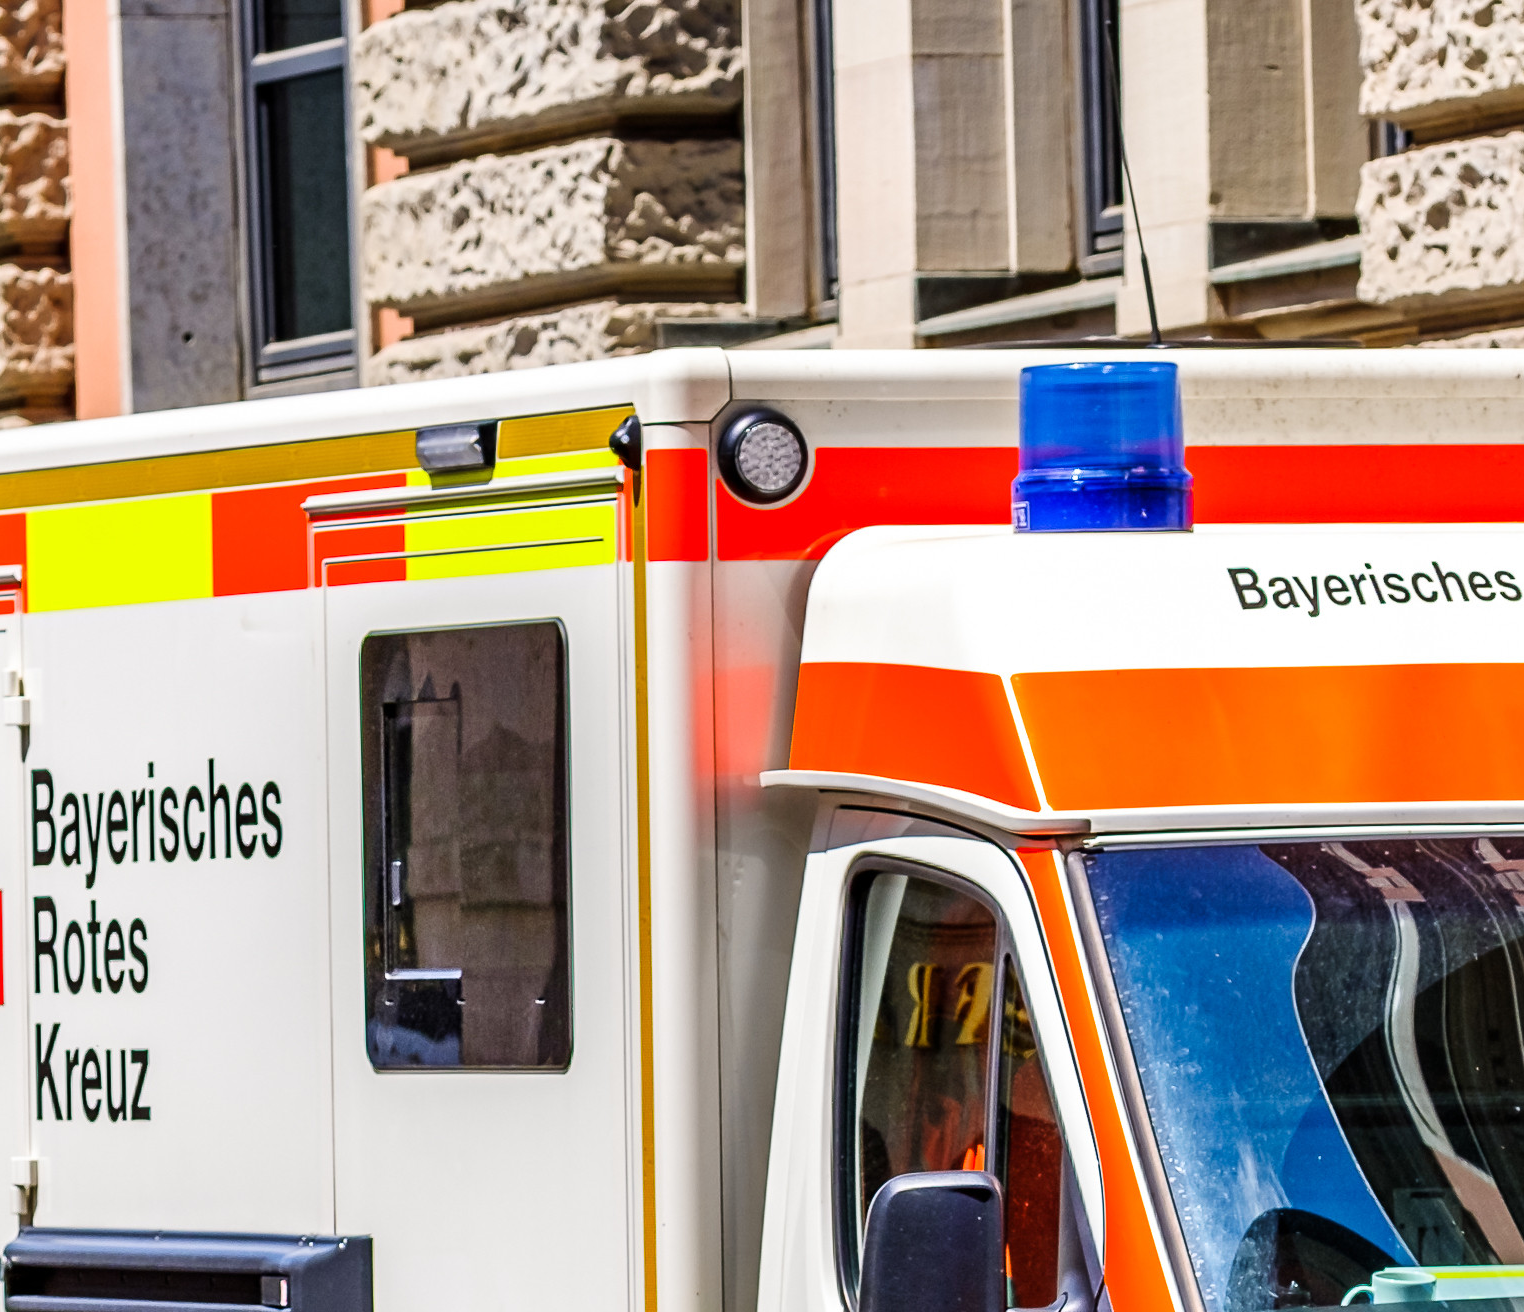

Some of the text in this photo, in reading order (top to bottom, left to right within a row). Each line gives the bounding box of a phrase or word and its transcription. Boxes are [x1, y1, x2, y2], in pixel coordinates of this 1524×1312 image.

[1227, 561, 1523, 618] Bayerisches
[31, 758, 284, 890] Bayerisches
[33, 895, 150, 995] Rotes
[35, 1023, 152, 1123] Kreuz
